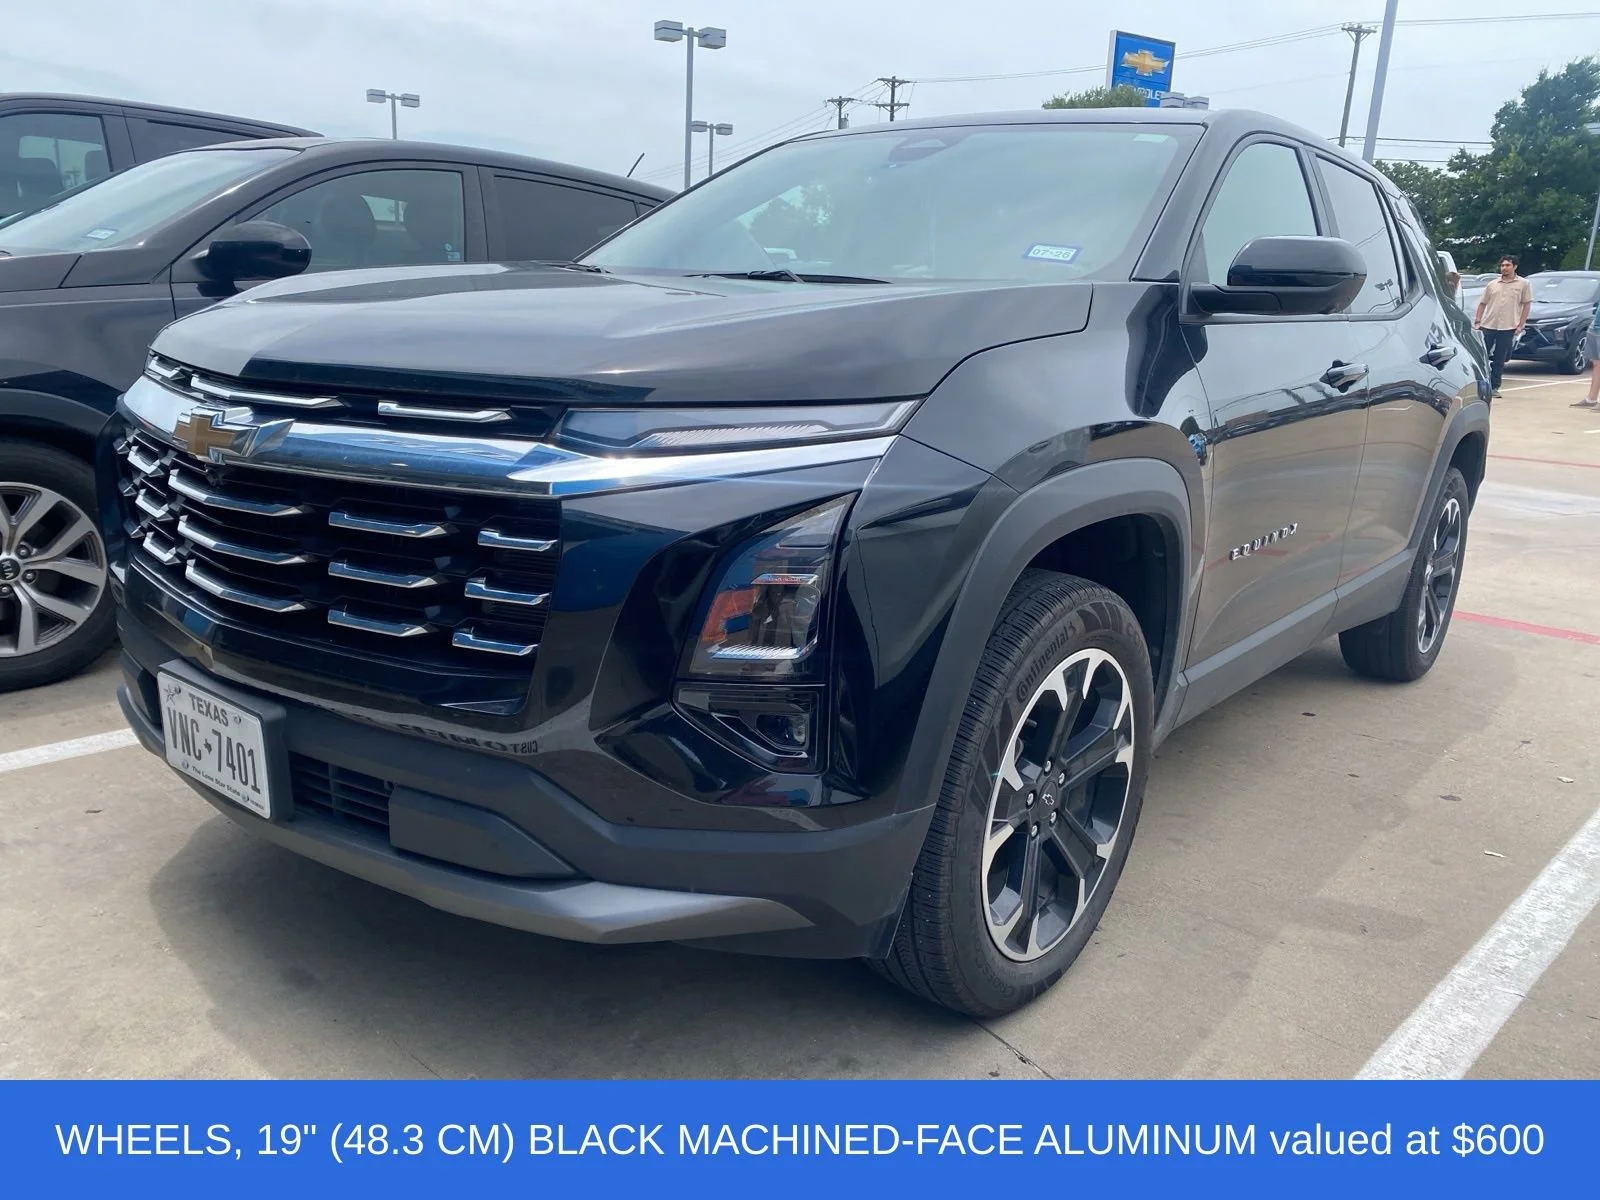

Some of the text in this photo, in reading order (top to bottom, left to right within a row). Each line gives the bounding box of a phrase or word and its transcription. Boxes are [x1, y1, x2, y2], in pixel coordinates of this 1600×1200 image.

[1229, 523, 1298, 560] EQUINOX
[2, 560, 14, 579] KIA
[1016, 626, 1069, 703] Continental
[189, 693, 229, 727] TEXAS
[167, 707, 261, 794] VNC 7401
[192, 766, 240, 796] The Lone Star State
